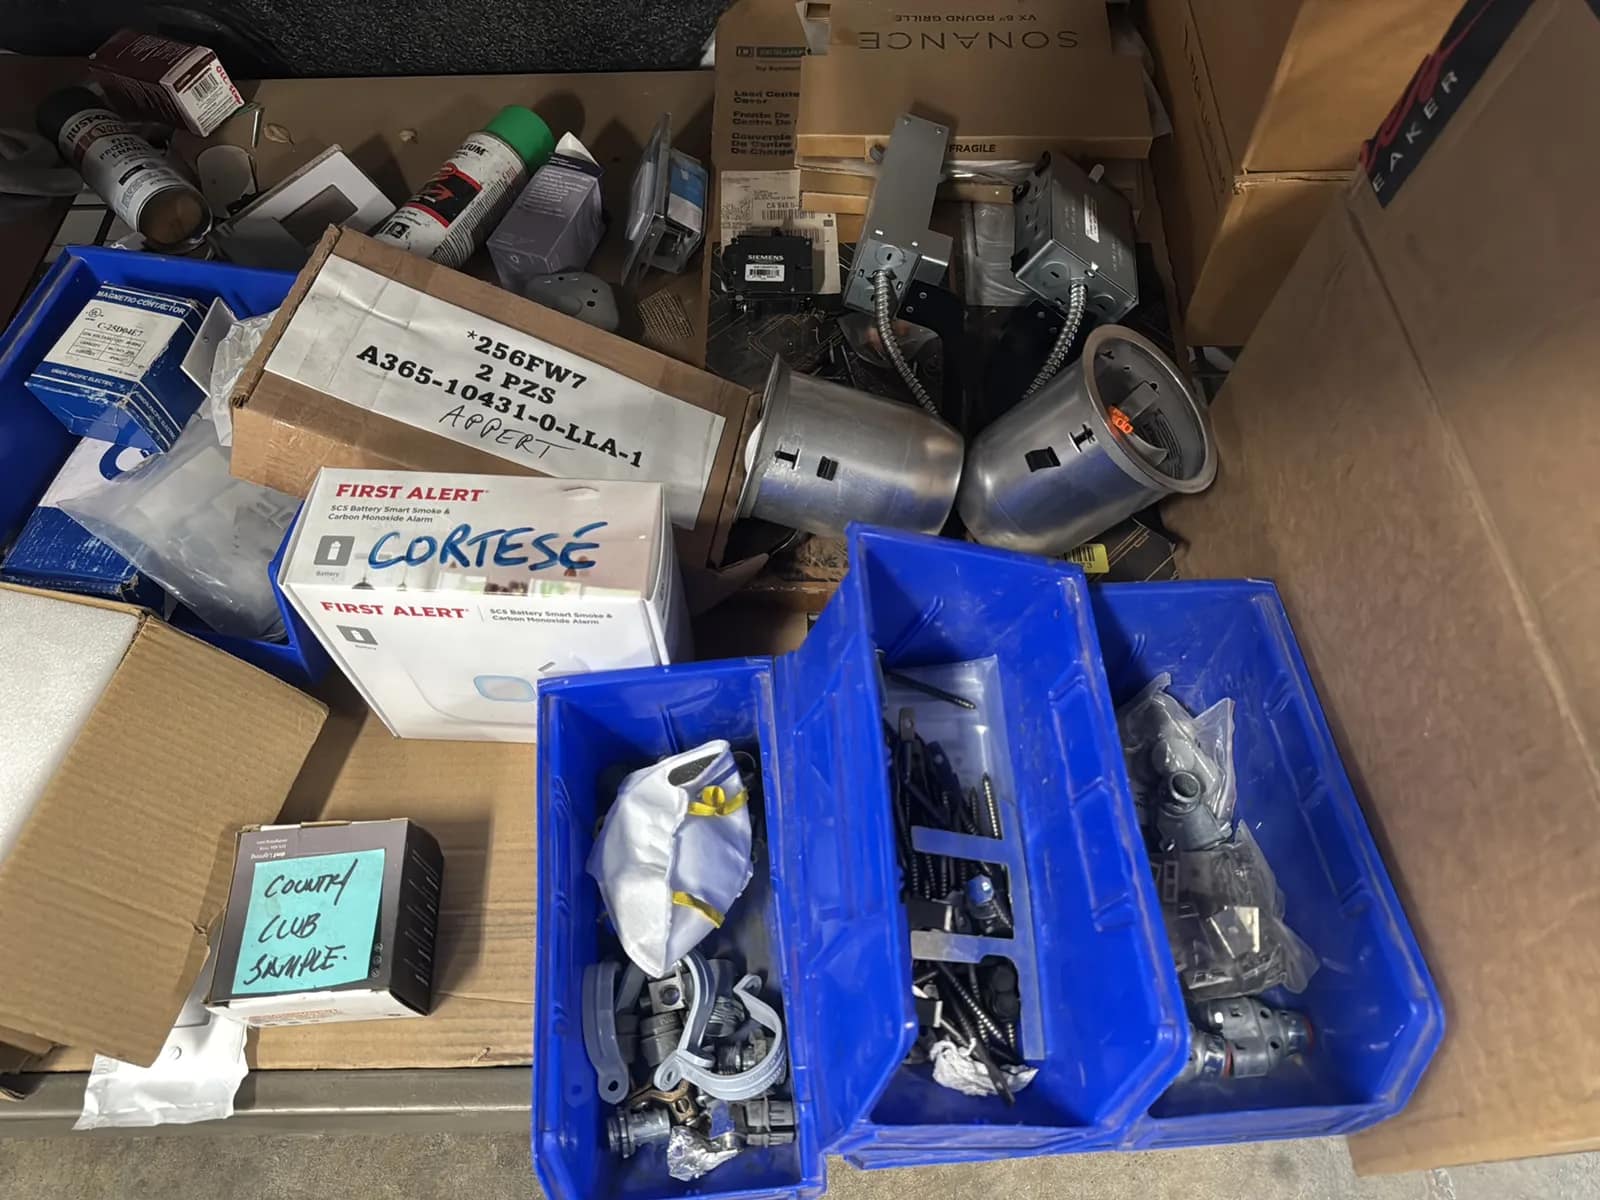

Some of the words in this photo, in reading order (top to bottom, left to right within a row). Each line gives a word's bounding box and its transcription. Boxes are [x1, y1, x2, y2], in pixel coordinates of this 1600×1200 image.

[895, 14, 942, 22] GRILLE
[946, 14, 996, 22] ROUND
[858, 31, 1079, 50] SONANCE
[766, 90, 801, 98] Cente
[1372, 72, 1459, 192] EAKER
[949, 144, 997, 153] FRAGILE
[137, 297, 186, 315] CONTACTOR
[475, 364, 494, 382] 2
[500, 372, 557, 404] PZS
[356, 345, 643, 468] A365-10431-0-LLA-1
[439, 405, 577, 459] APPERT
[336, 484, 403, 499] FIRST
[406, 487, 485, 502] ALERT
[328, 513, 360, 521] Carbon
[361, 514, 404, 522] Monoxide
[350, 506, 383, 514] Battery
[384, 506, 410, 514] Smart
[412, 507, 442, 515] Smoke
[321, 602, 385, 616] FIRST
[393, 605, 466, 619] ALERT
[510, 609, 543, 617] Battery
[264, 858, 358, 906] COUNTRY
[258, 912, 321, 944] CLUB
